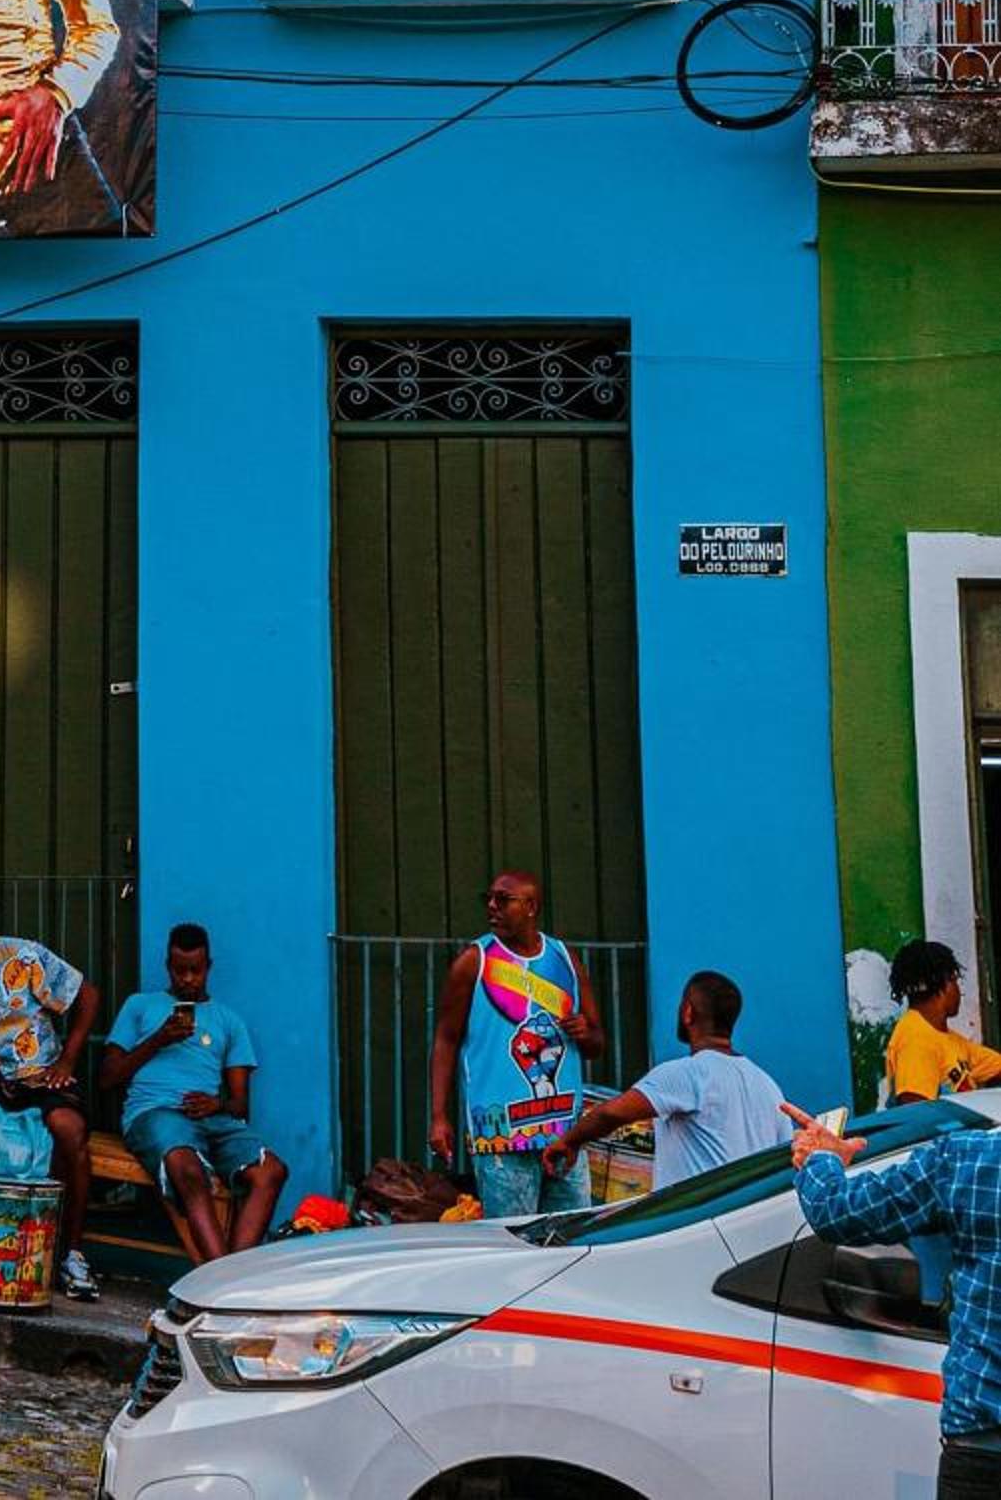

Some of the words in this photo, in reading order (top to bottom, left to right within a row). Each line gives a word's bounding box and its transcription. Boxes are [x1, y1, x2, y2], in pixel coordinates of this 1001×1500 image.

[701, 527, 760, 540] LARGO
[680, 542, 699, 561] DO
[702, 542, 784, 561] PELOURINHO
